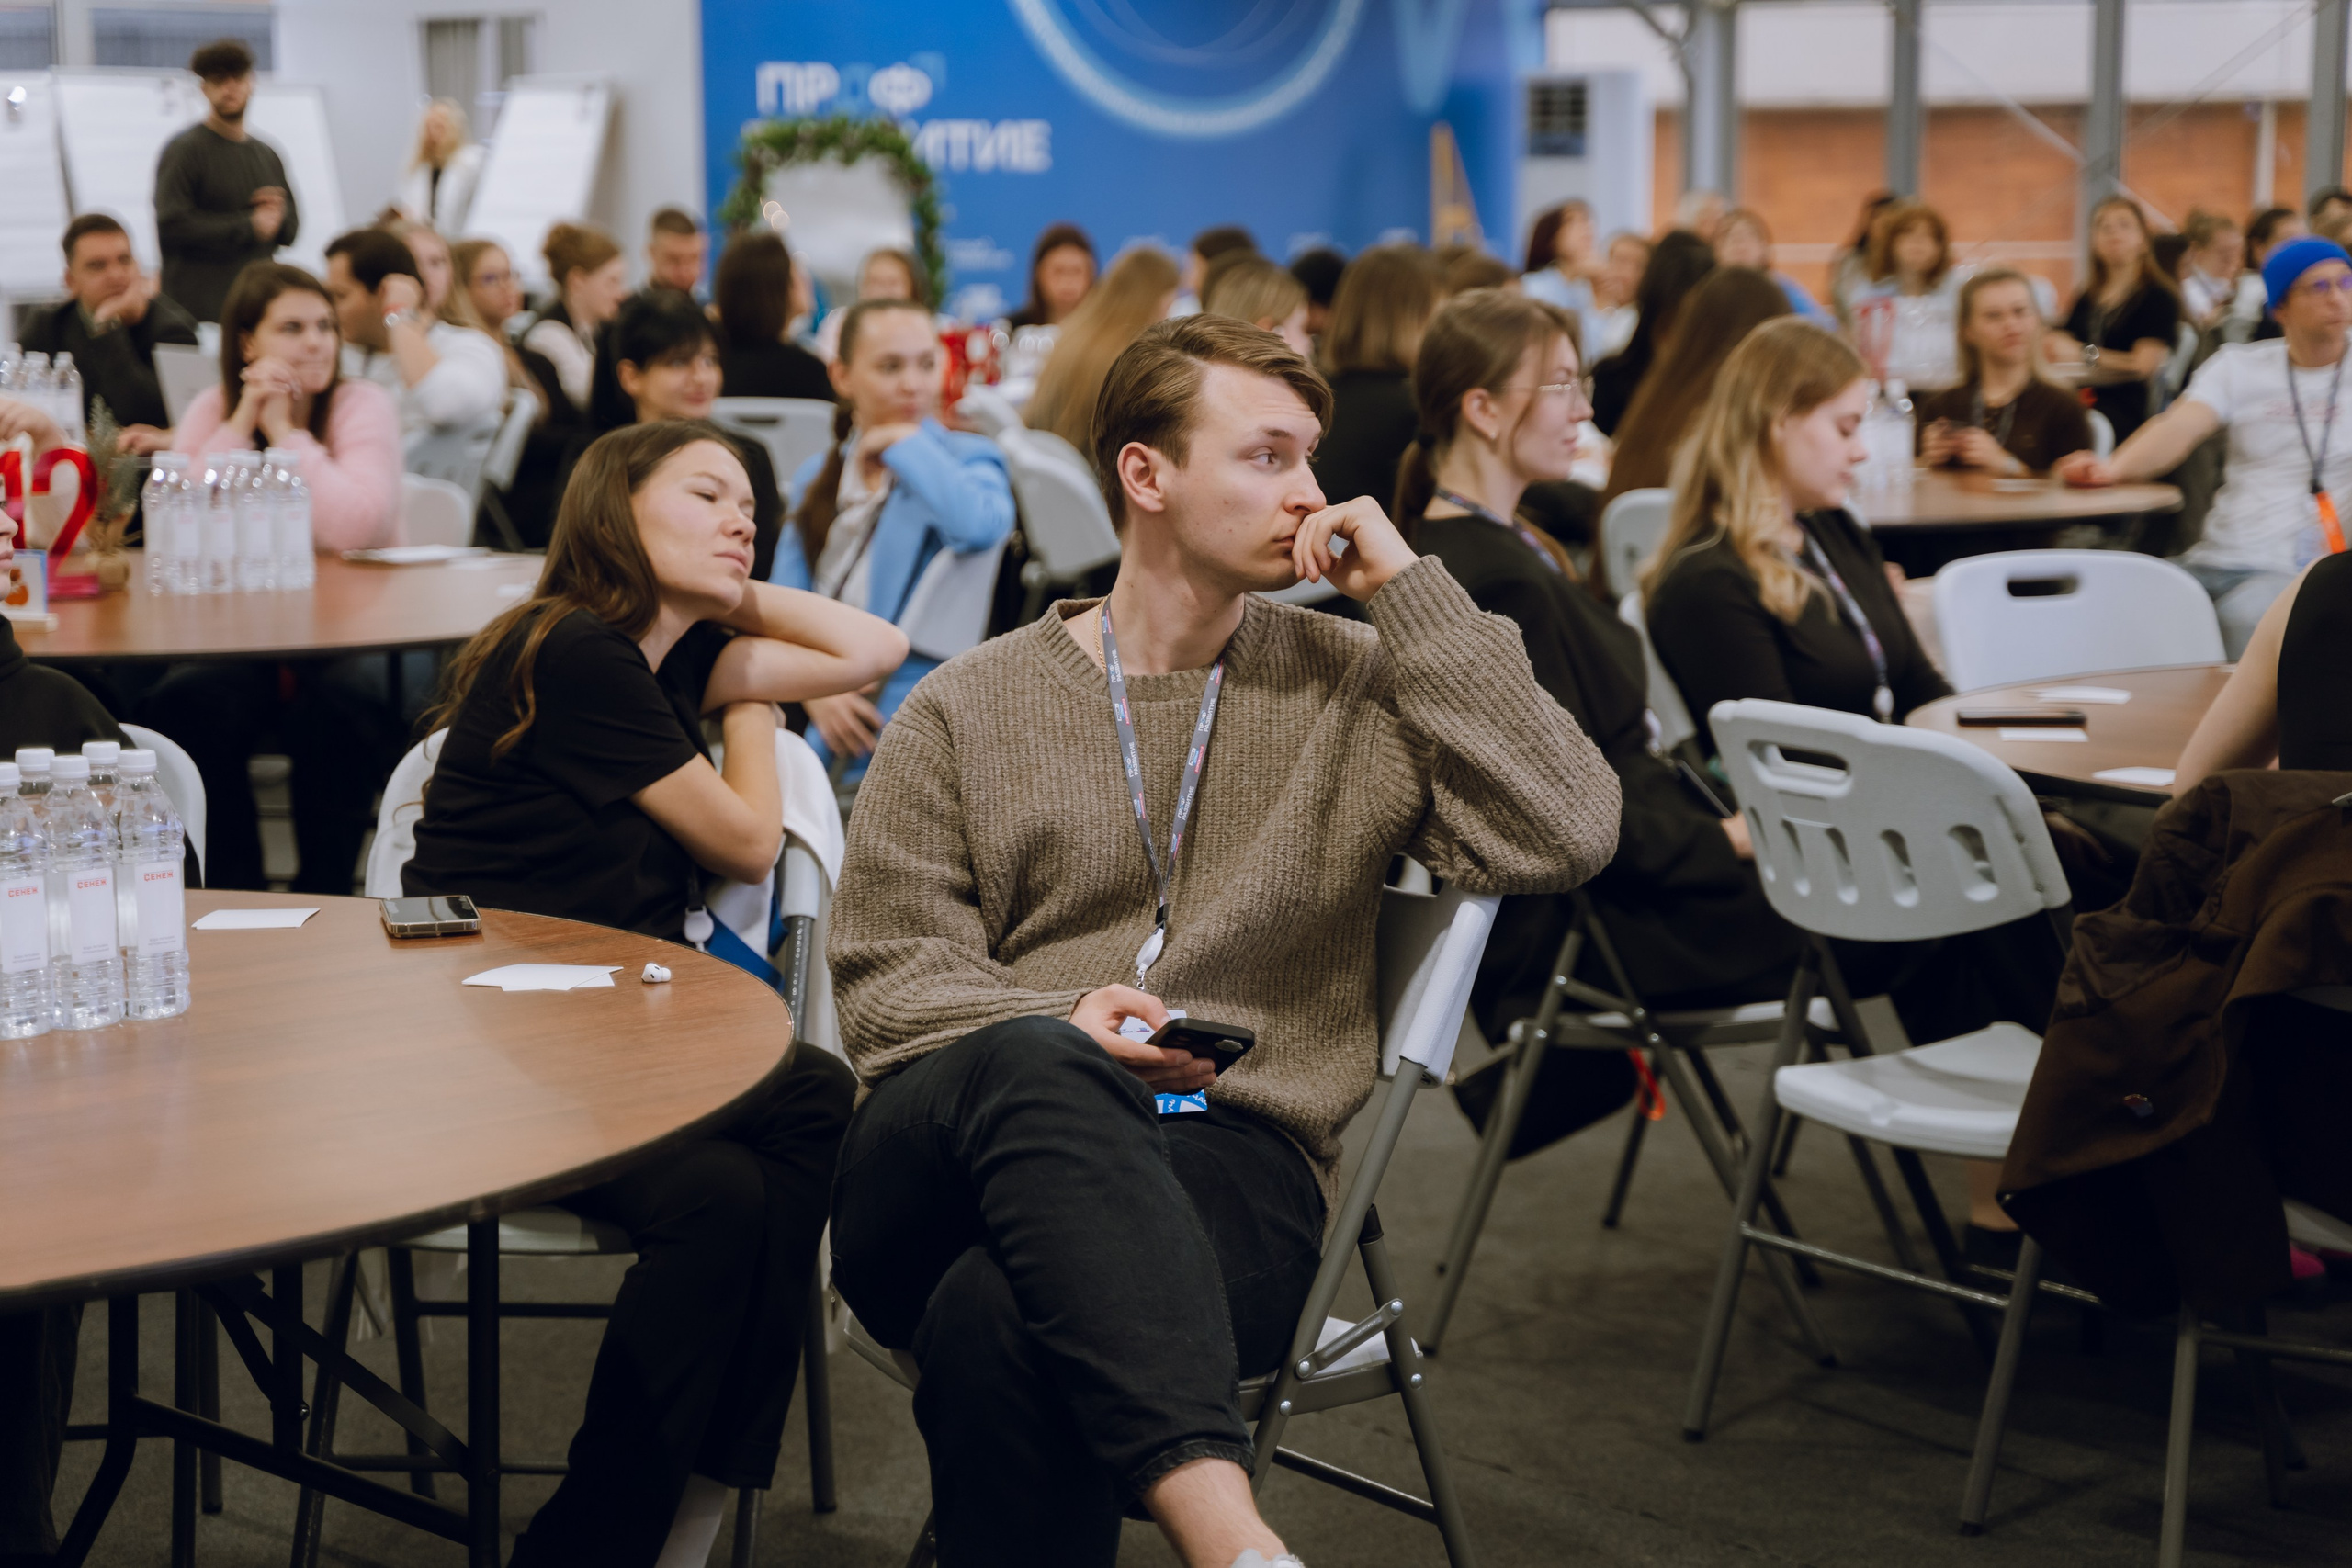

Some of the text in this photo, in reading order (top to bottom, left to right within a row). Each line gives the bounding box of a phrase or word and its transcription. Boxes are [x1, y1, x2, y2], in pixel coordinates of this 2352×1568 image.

[1204, 698, 1216, 732] РАЗВИТИЕ
[1129, 742, 1139, 775] РАЗВИТИЕ
[1182, 786, 1194, 820] РАЗВИТИЕ
[77, 878, 107, 889] СЕНЕЖ
[144, 871, 174, 882] СЕНЕЖ
[8, 886, 38, 897] СЕНЕЖ
